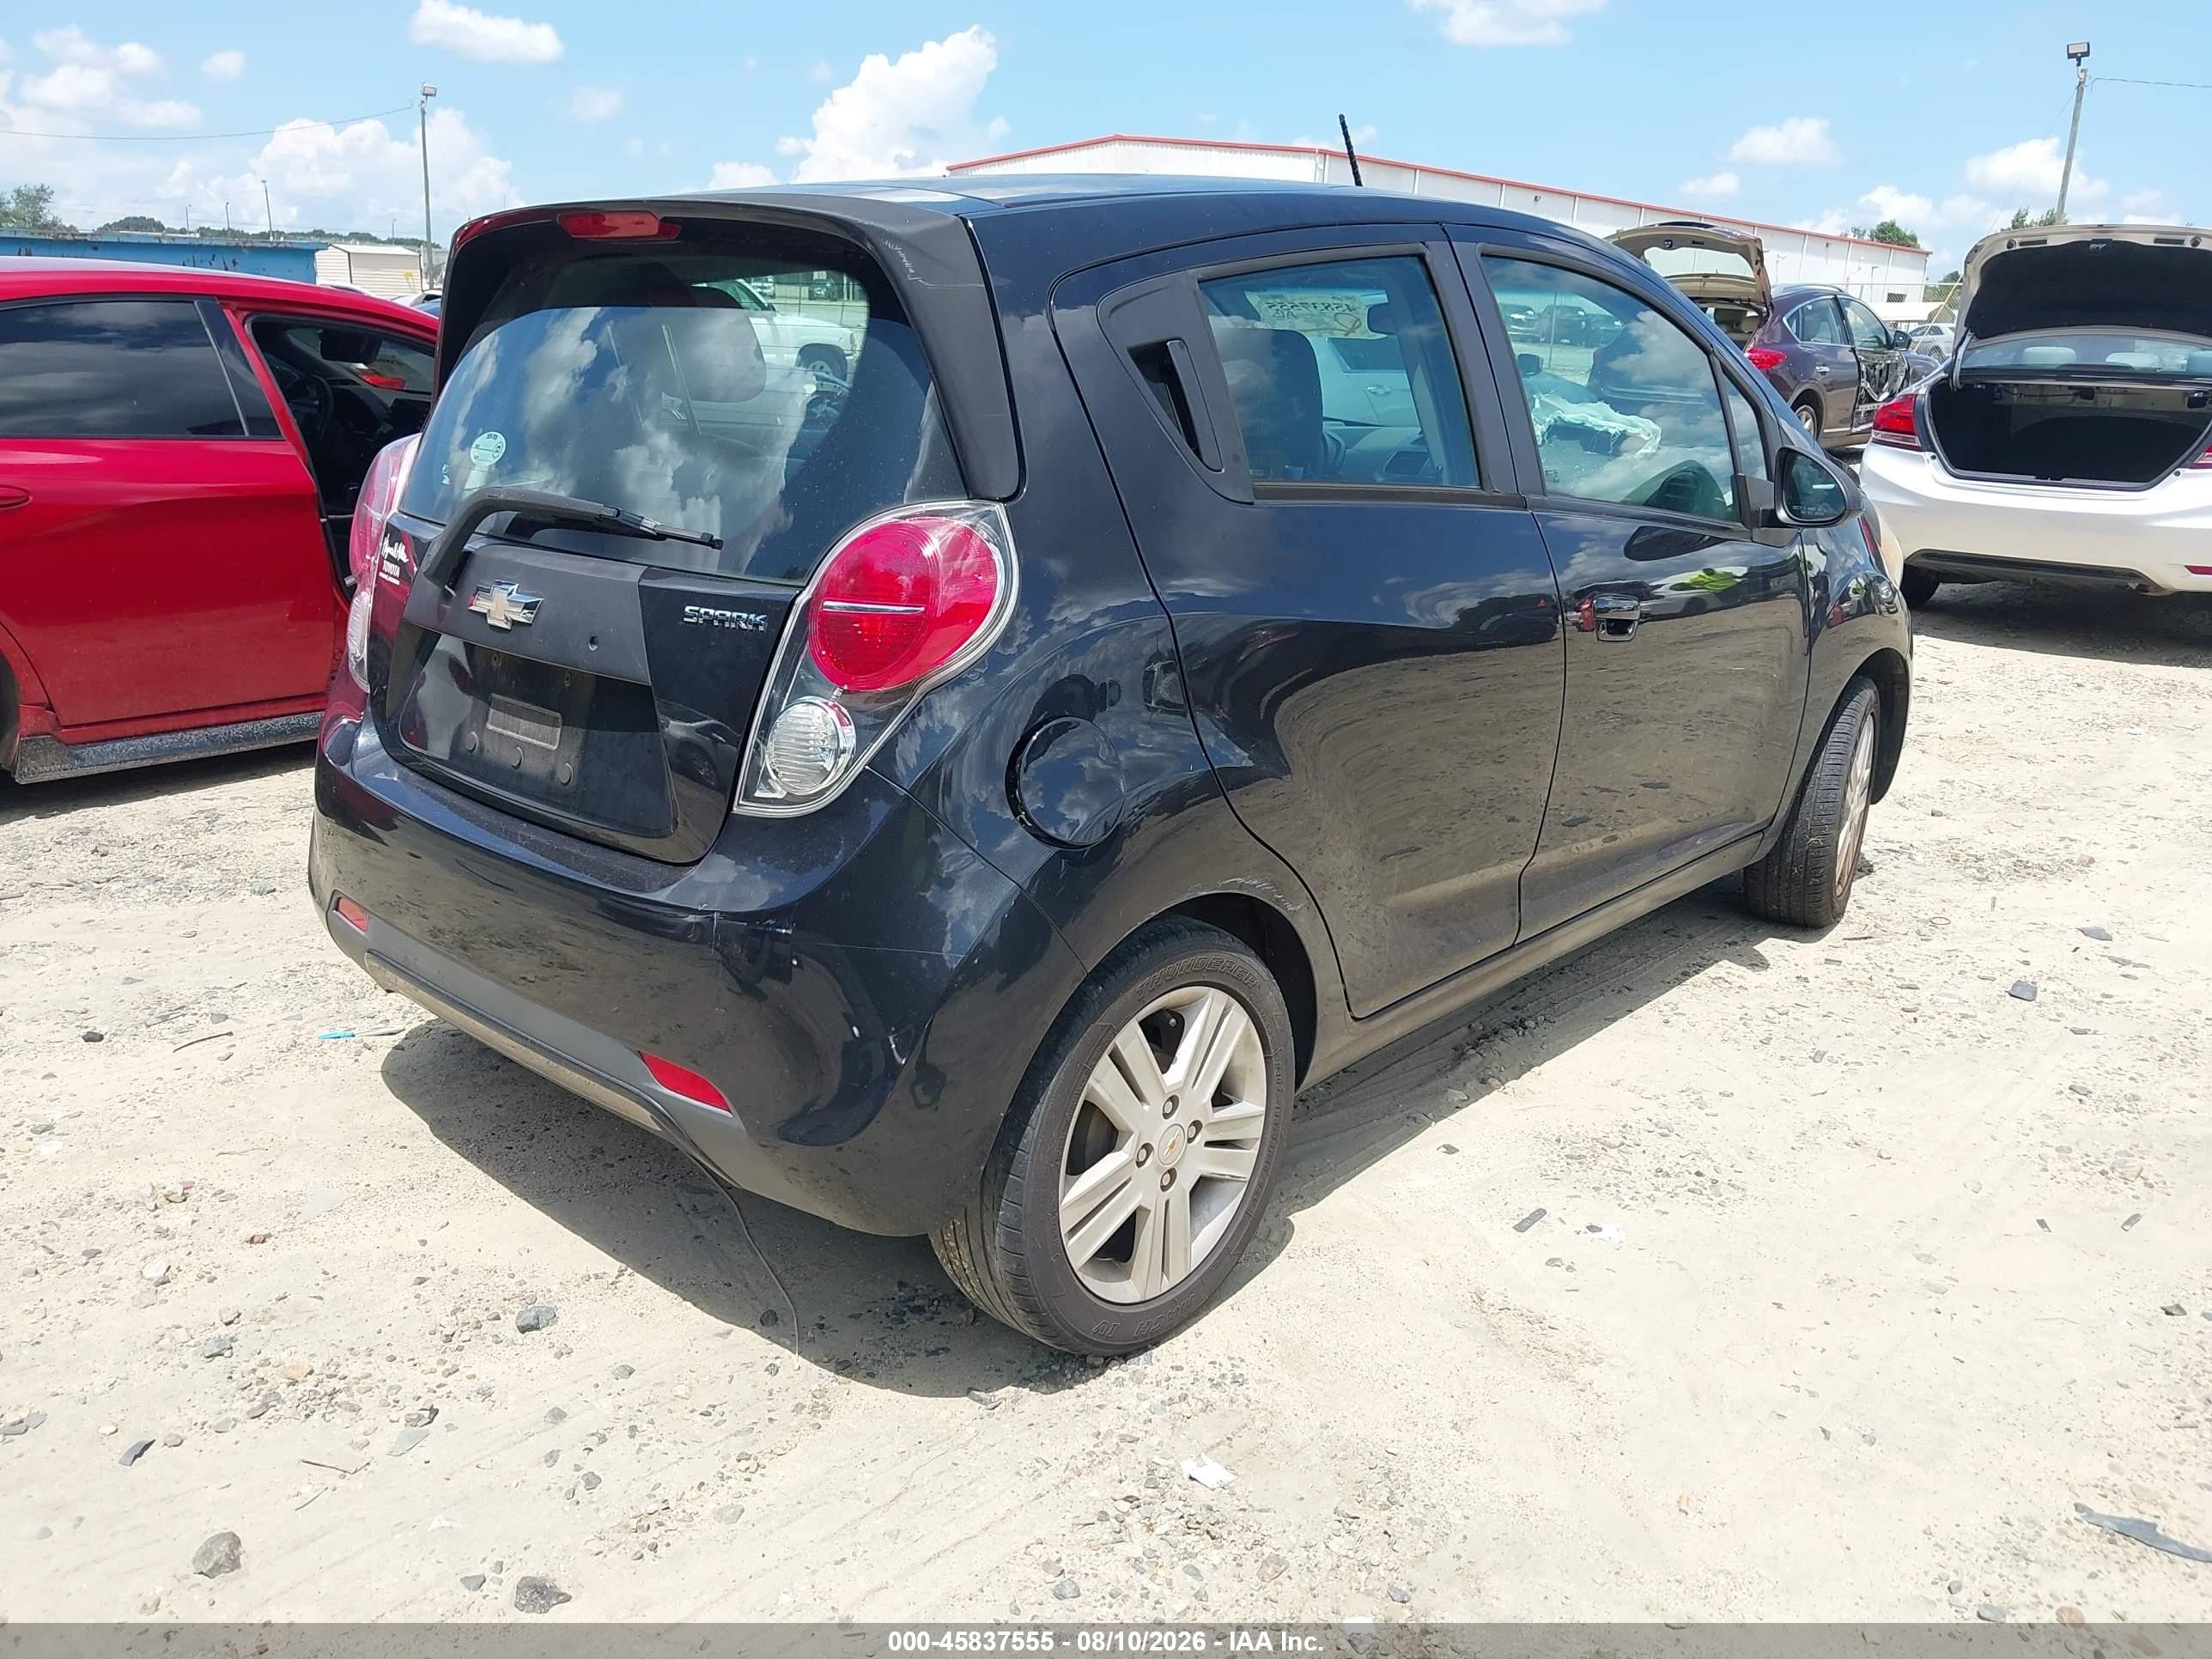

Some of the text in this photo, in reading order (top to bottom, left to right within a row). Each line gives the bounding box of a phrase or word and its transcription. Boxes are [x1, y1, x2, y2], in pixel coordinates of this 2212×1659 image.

[382, 560, 401, 579] TOYOTA
[683, 605, 768, 632] SPARK
[1135, 956, 1259, 997] THUNDERER
